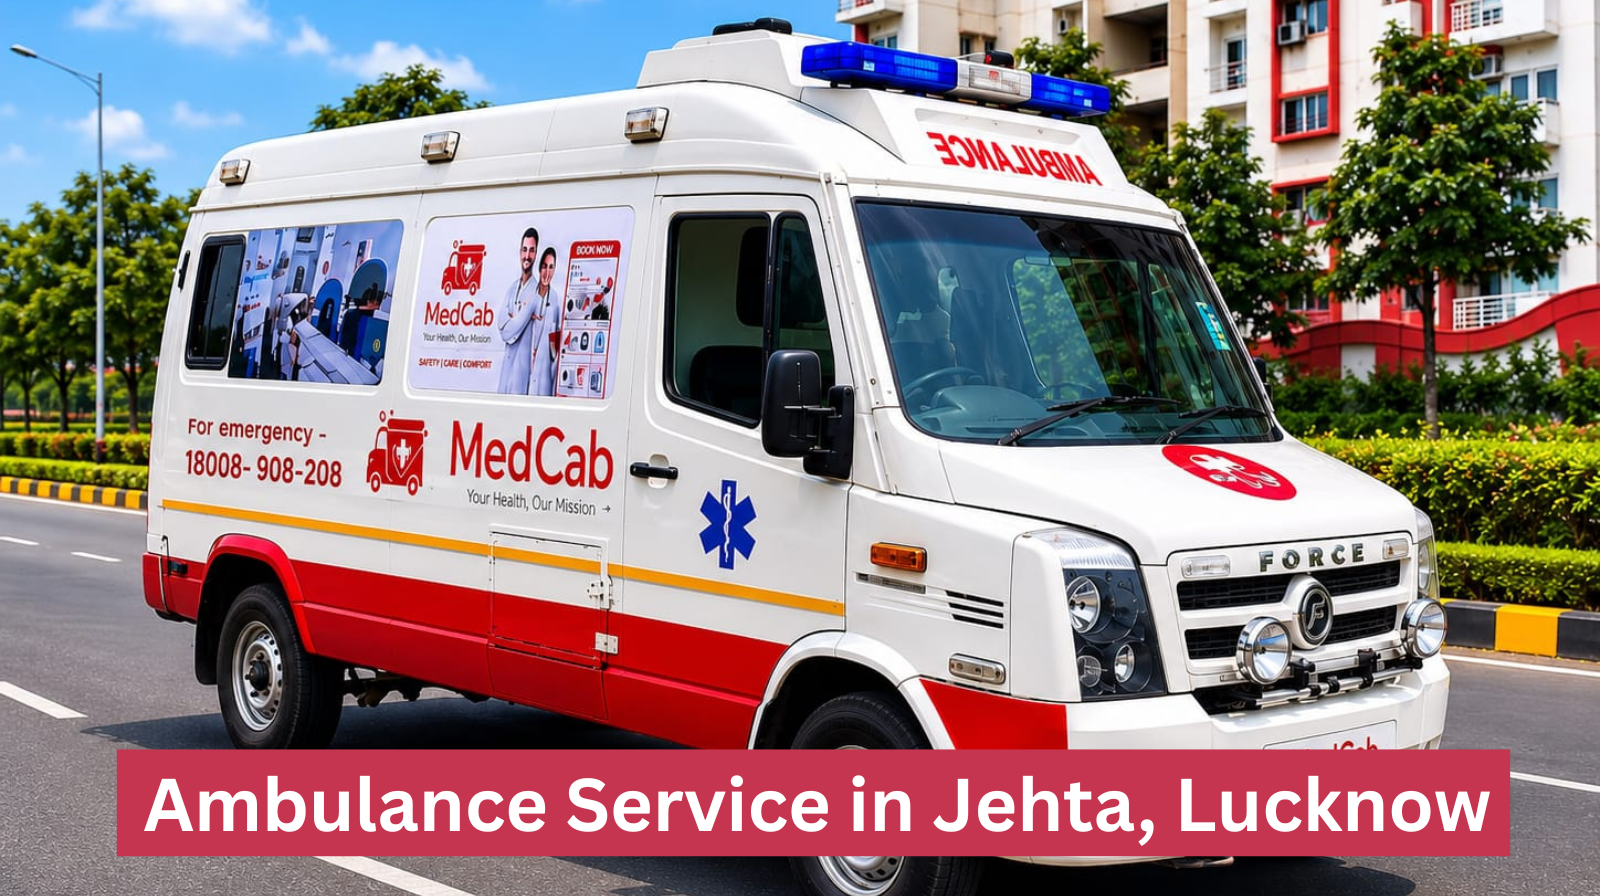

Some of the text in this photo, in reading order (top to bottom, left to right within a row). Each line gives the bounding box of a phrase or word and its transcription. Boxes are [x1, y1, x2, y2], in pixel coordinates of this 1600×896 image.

[577, 245, 613, 255] BOOK NOW
[424, 301, 494, 326] MedCab
[423, 332, 492, 344] Your Health, Our Mission
[419, 358, 440, 366] SAFETY
[443, 358, 459, 368] CARE
[462, 361, 492, 369] COMFORT
[188, 418, 214, 436] For
[219, 421, 313, 447] emergency
[449, 420, 614, 490] MedCab
[185, 450, 342, 488] 18008- 908-208
[467, 489, 596, 516] Your Health, Our Mission
[1259, 543, 1364, 573] FORCE
